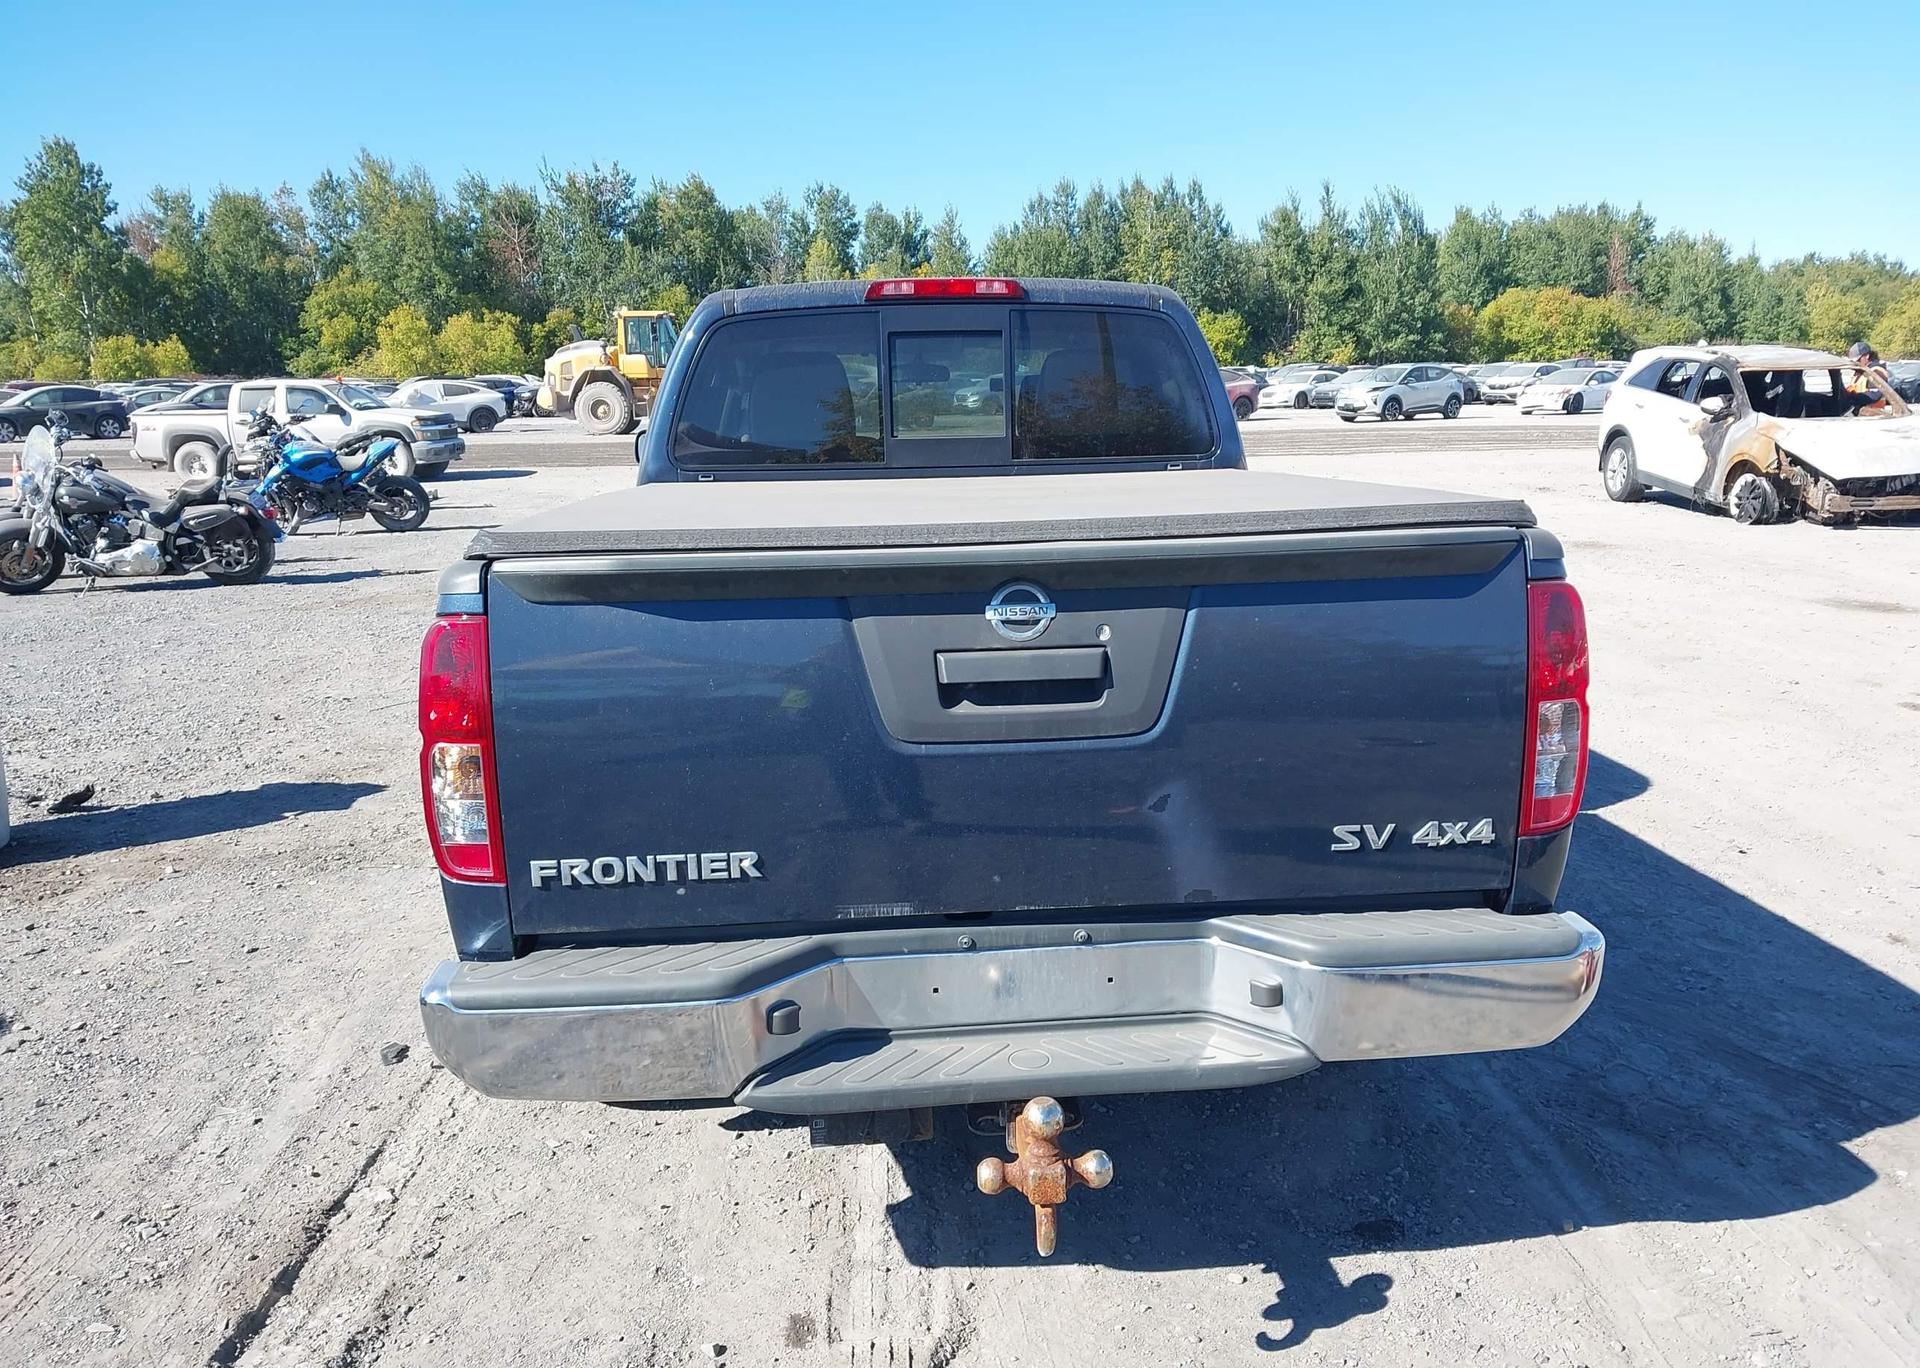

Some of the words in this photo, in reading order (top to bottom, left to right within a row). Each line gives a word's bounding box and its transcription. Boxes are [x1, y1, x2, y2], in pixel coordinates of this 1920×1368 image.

[992, 606, 1049, 617] NISSAN
[1331, 823, 1396, 851] SV
[529, 851, 763, 888] FRONTIER
